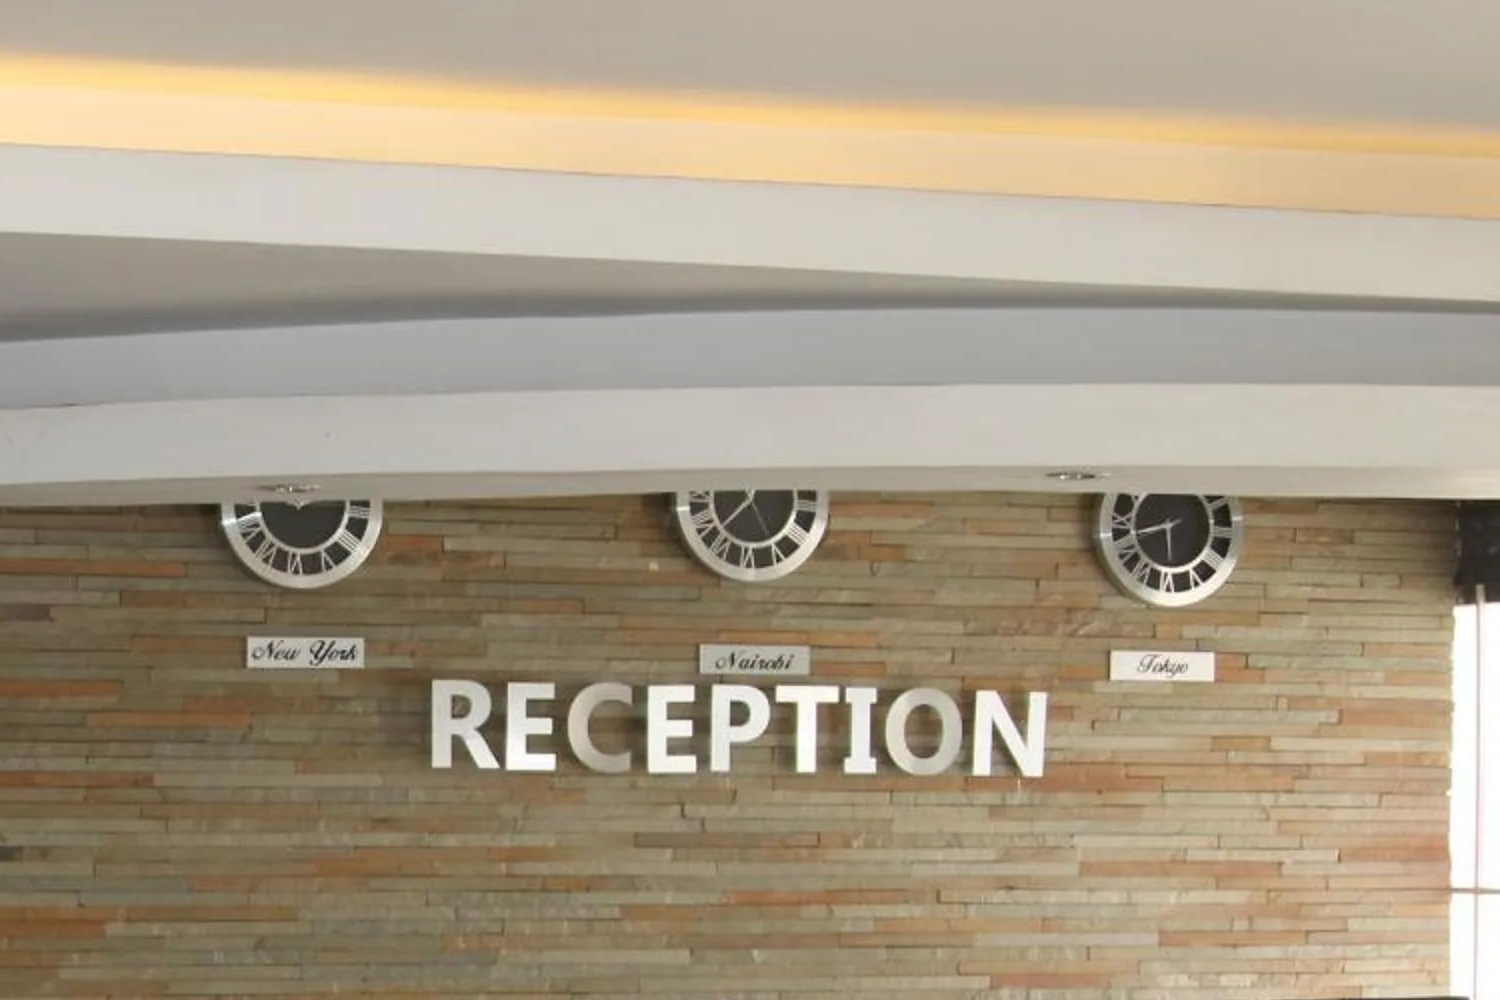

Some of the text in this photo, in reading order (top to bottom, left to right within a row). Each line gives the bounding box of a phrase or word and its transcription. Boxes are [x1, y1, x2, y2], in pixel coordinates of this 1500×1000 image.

[251, 639, 357, 667] New York
[715, 648, 795, 670] Nairobi
[1137, 653, 1189, 678] Tokyo
[430, 678, 1049, 778] RECEPTION
